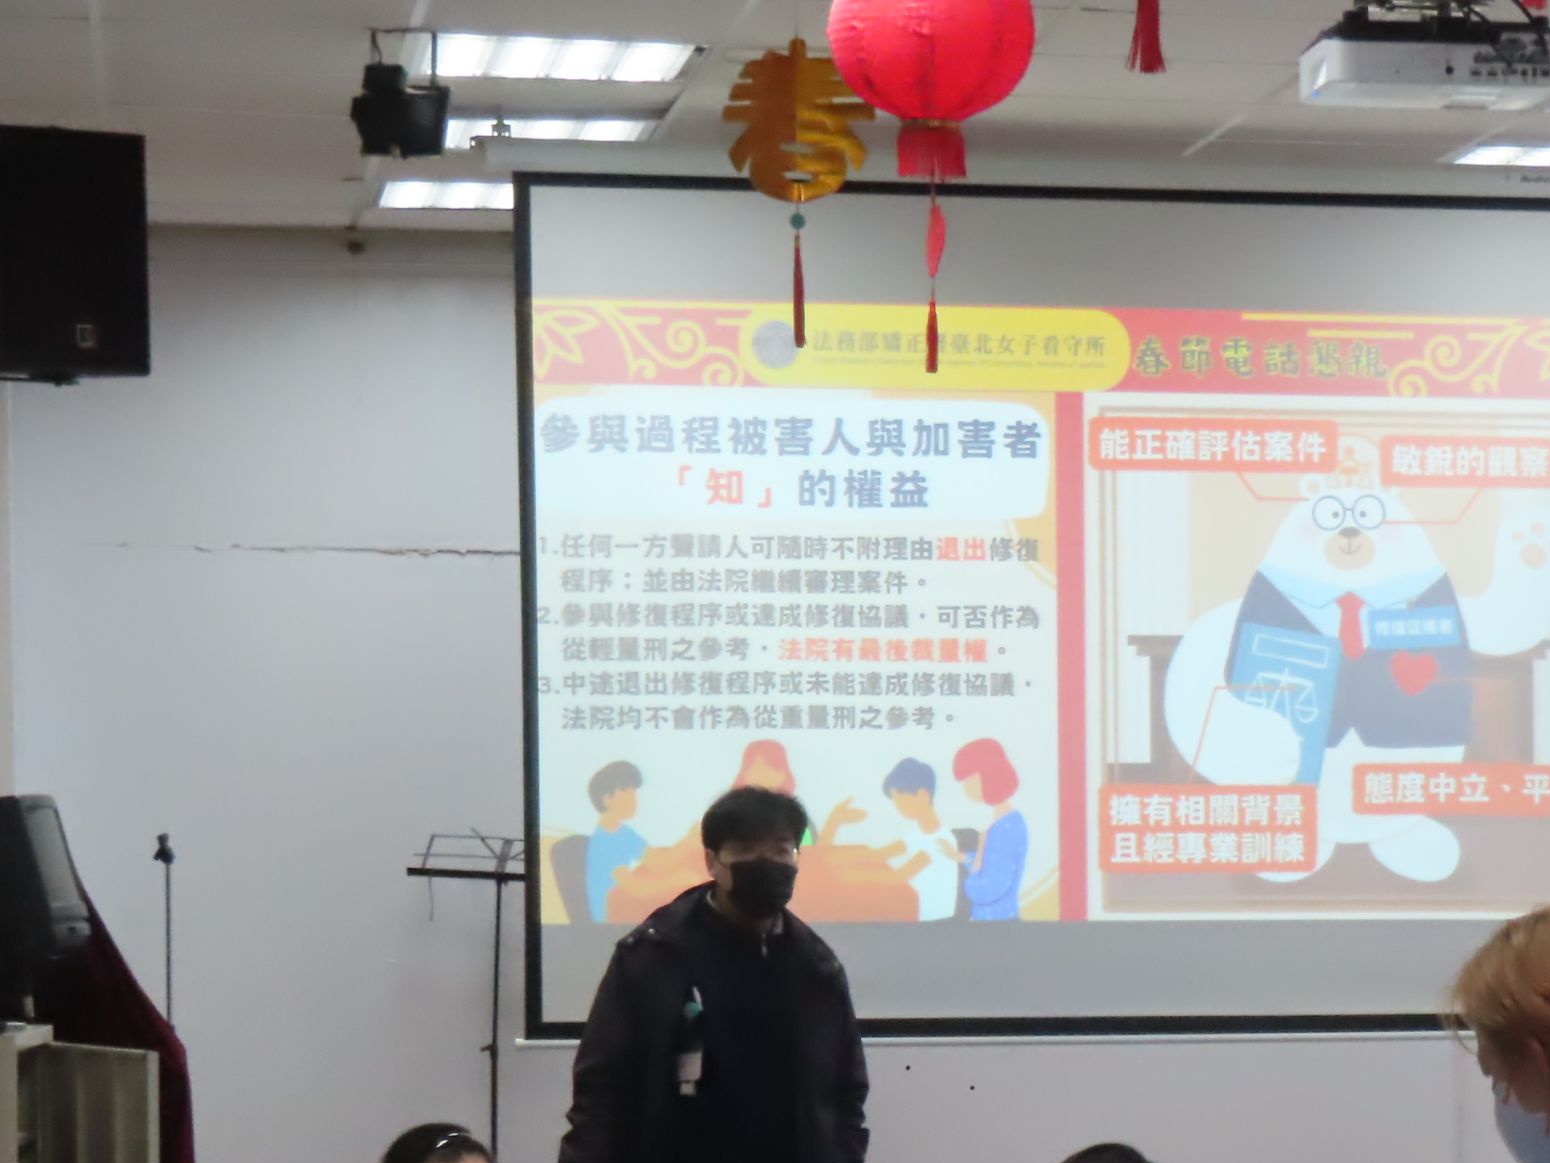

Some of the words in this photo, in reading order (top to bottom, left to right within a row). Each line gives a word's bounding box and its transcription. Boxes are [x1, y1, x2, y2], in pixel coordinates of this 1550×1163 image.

[540, 414, 1042, 460] 參與過程被害人與加害者
[1099, 429, 1327, 463] 能正確評估案件
[677, 465, 930, 510] 「知」的權益
[1110, 793, 1305, 827] 擁有相關背景
[1110, 831, 1305, 865] 且經專業訓練
